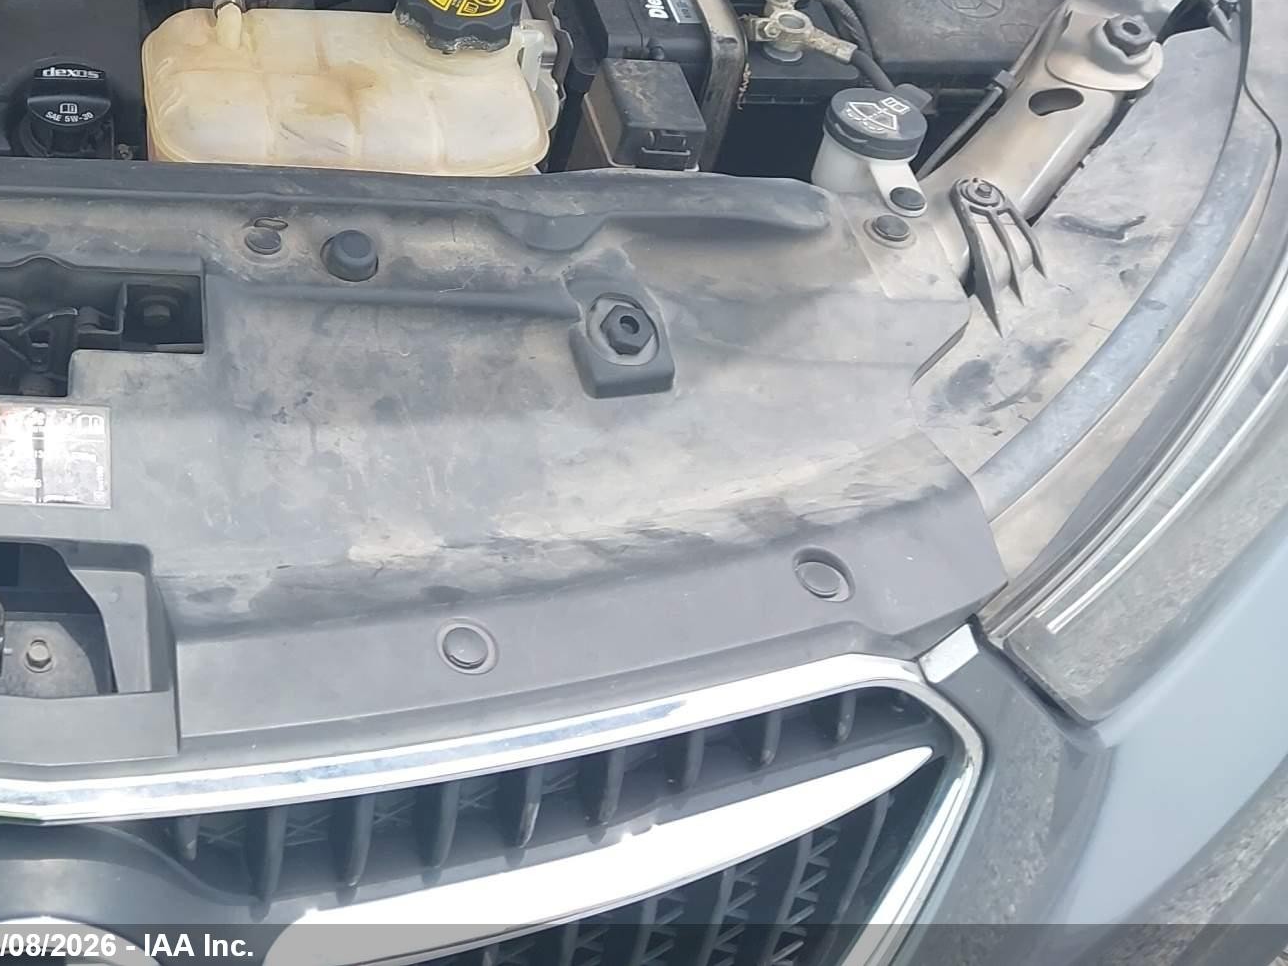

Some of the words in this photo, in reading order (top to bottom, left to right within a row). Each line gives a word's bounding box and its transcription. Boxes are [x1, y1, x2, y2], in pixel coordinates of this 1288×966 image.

[42, 67, 102, 79] dexos
[45, 111, 62, 122] SAE
[64, 112, 94, 123] 5W-30
